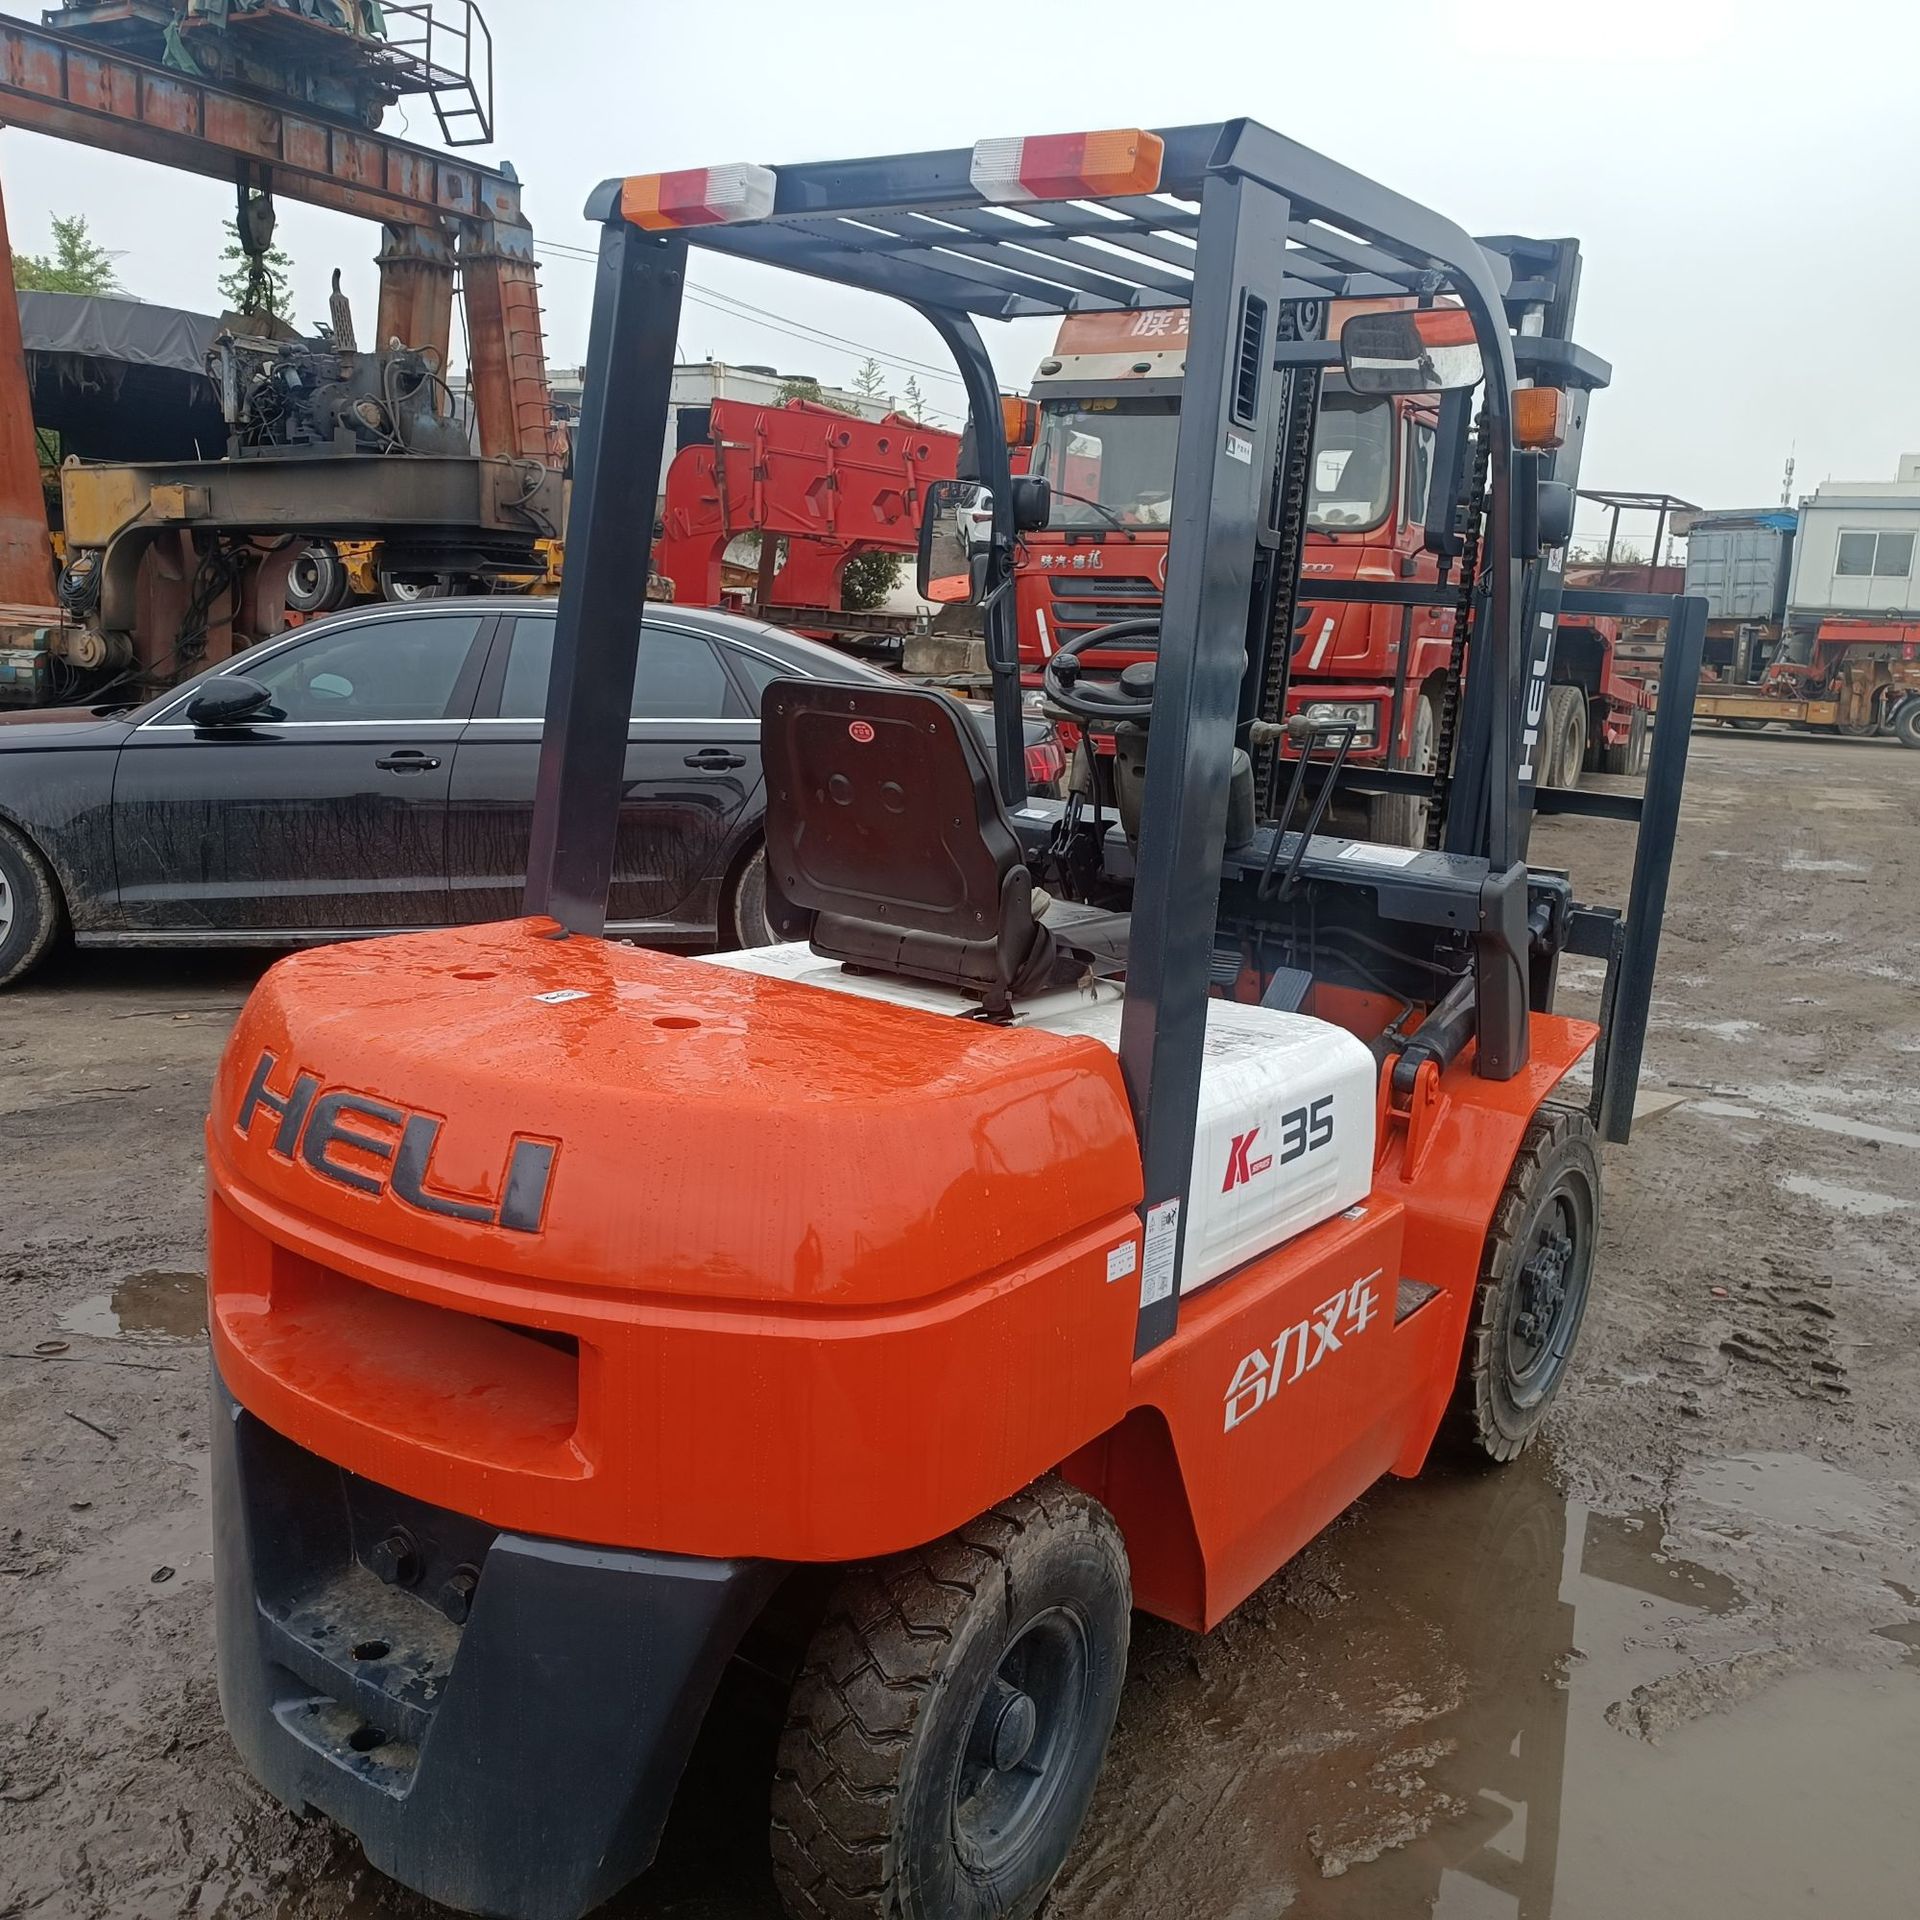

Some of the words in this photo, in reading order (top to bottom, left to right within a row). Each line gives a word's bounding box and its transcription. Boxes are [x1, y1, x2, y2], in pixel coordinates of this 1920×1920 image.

[1518, 612, 1555, 780] HELI
[234, 1050, 560, 1234] HELI
[1221, 1126, 1261, 1194] K
[1280, 1094, 1334, 1166] 35
[1222, 1267, 1384, 1434] 合力叉车
